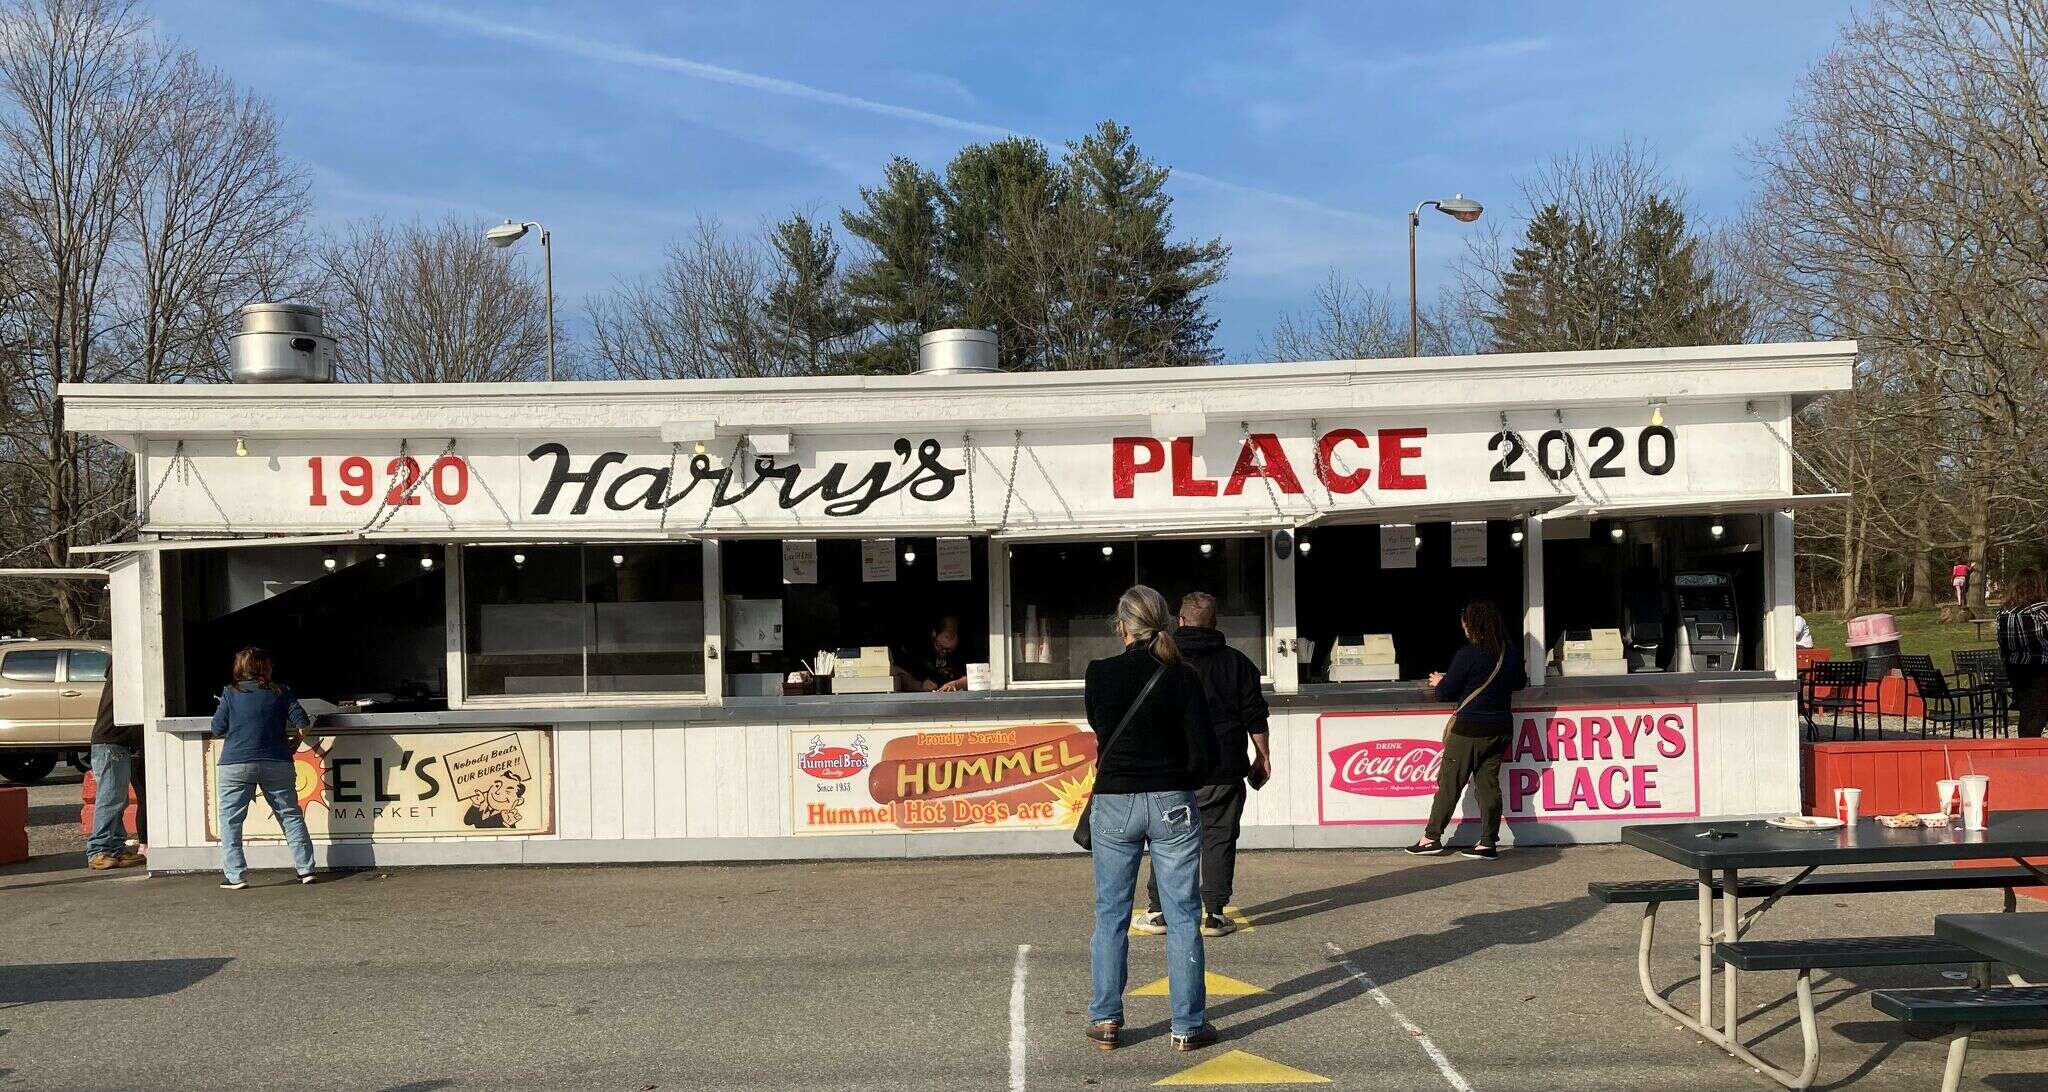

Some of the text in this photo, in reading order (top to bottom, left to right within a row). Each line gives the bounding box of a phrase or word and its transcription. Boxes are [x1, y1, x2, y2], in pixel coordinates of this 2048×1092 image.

[1112, 427, 1428, 499] PLACE
[1489, 425, 1675, 482] 2020
[308, 455, 469, 506] 1920
[527, 437, 967, 517] Harry's
[917, 730, 1017, 746] Proudly Serving
[1504, 713, 1686, 763] ARRY'S
[453, 744, 518, 771] Nobody Beats
[456, 772, 475, 785] OUR
[477, 759, 513, 778] BURGER
[798, 752, 842, 769] Hummel
[896, 740, 1085, 797] HUMMEL
[816, 782, 852, 793] Since 1933
[1508, 764, 1662, 812] PLACE
[334, 806, 437, 819] MARKET
[807, 801, 897, 825] Hummel
[904, 799, 946, 824] Hot
[953, 800, 1010, 824] Dogs
[1017, 803, 1054, 819] are
